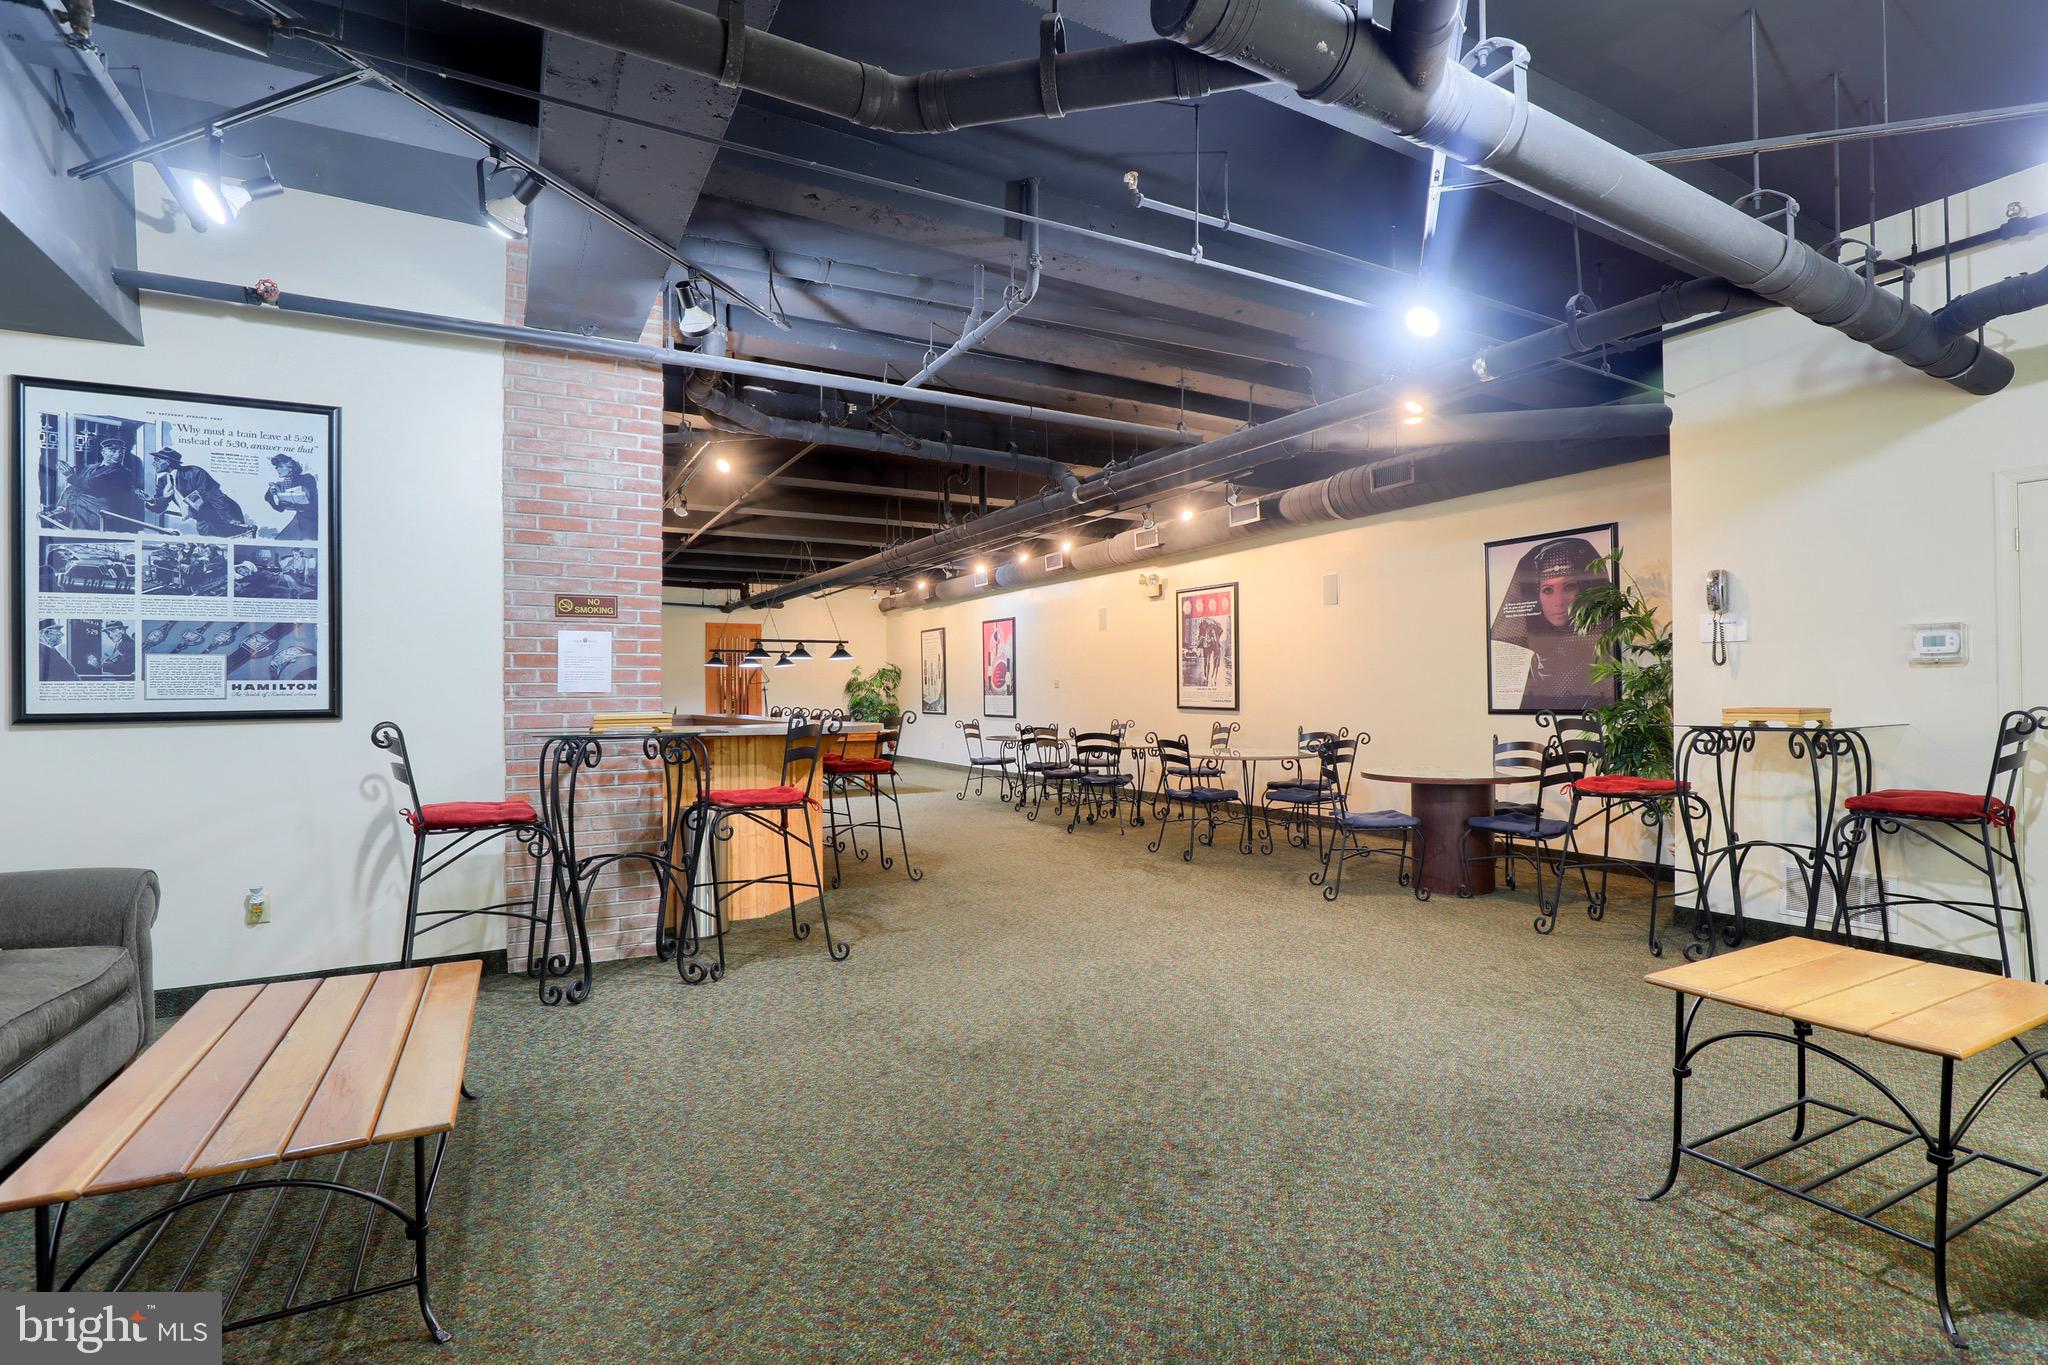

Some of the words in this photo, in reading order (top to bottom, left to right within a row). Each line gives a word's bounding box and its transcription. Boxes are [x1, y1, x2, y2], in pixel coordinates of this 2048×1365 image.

[203, 428, 225, 436] must
[236, 429, 257, 439] train
[260, 430, 281, 441] leave
[283, 433, 292, 442] at
[294, 434, 314, 444] 5:29
[178, 435, 211, 446] instead
[213, 438, 224, 447] of
[250, 443, 282, 452] answer
[587, 598, 600, 606] NO
[574, 606, 614, 614] SMOKING
[231, 683, 318, 691] HAMILTON
